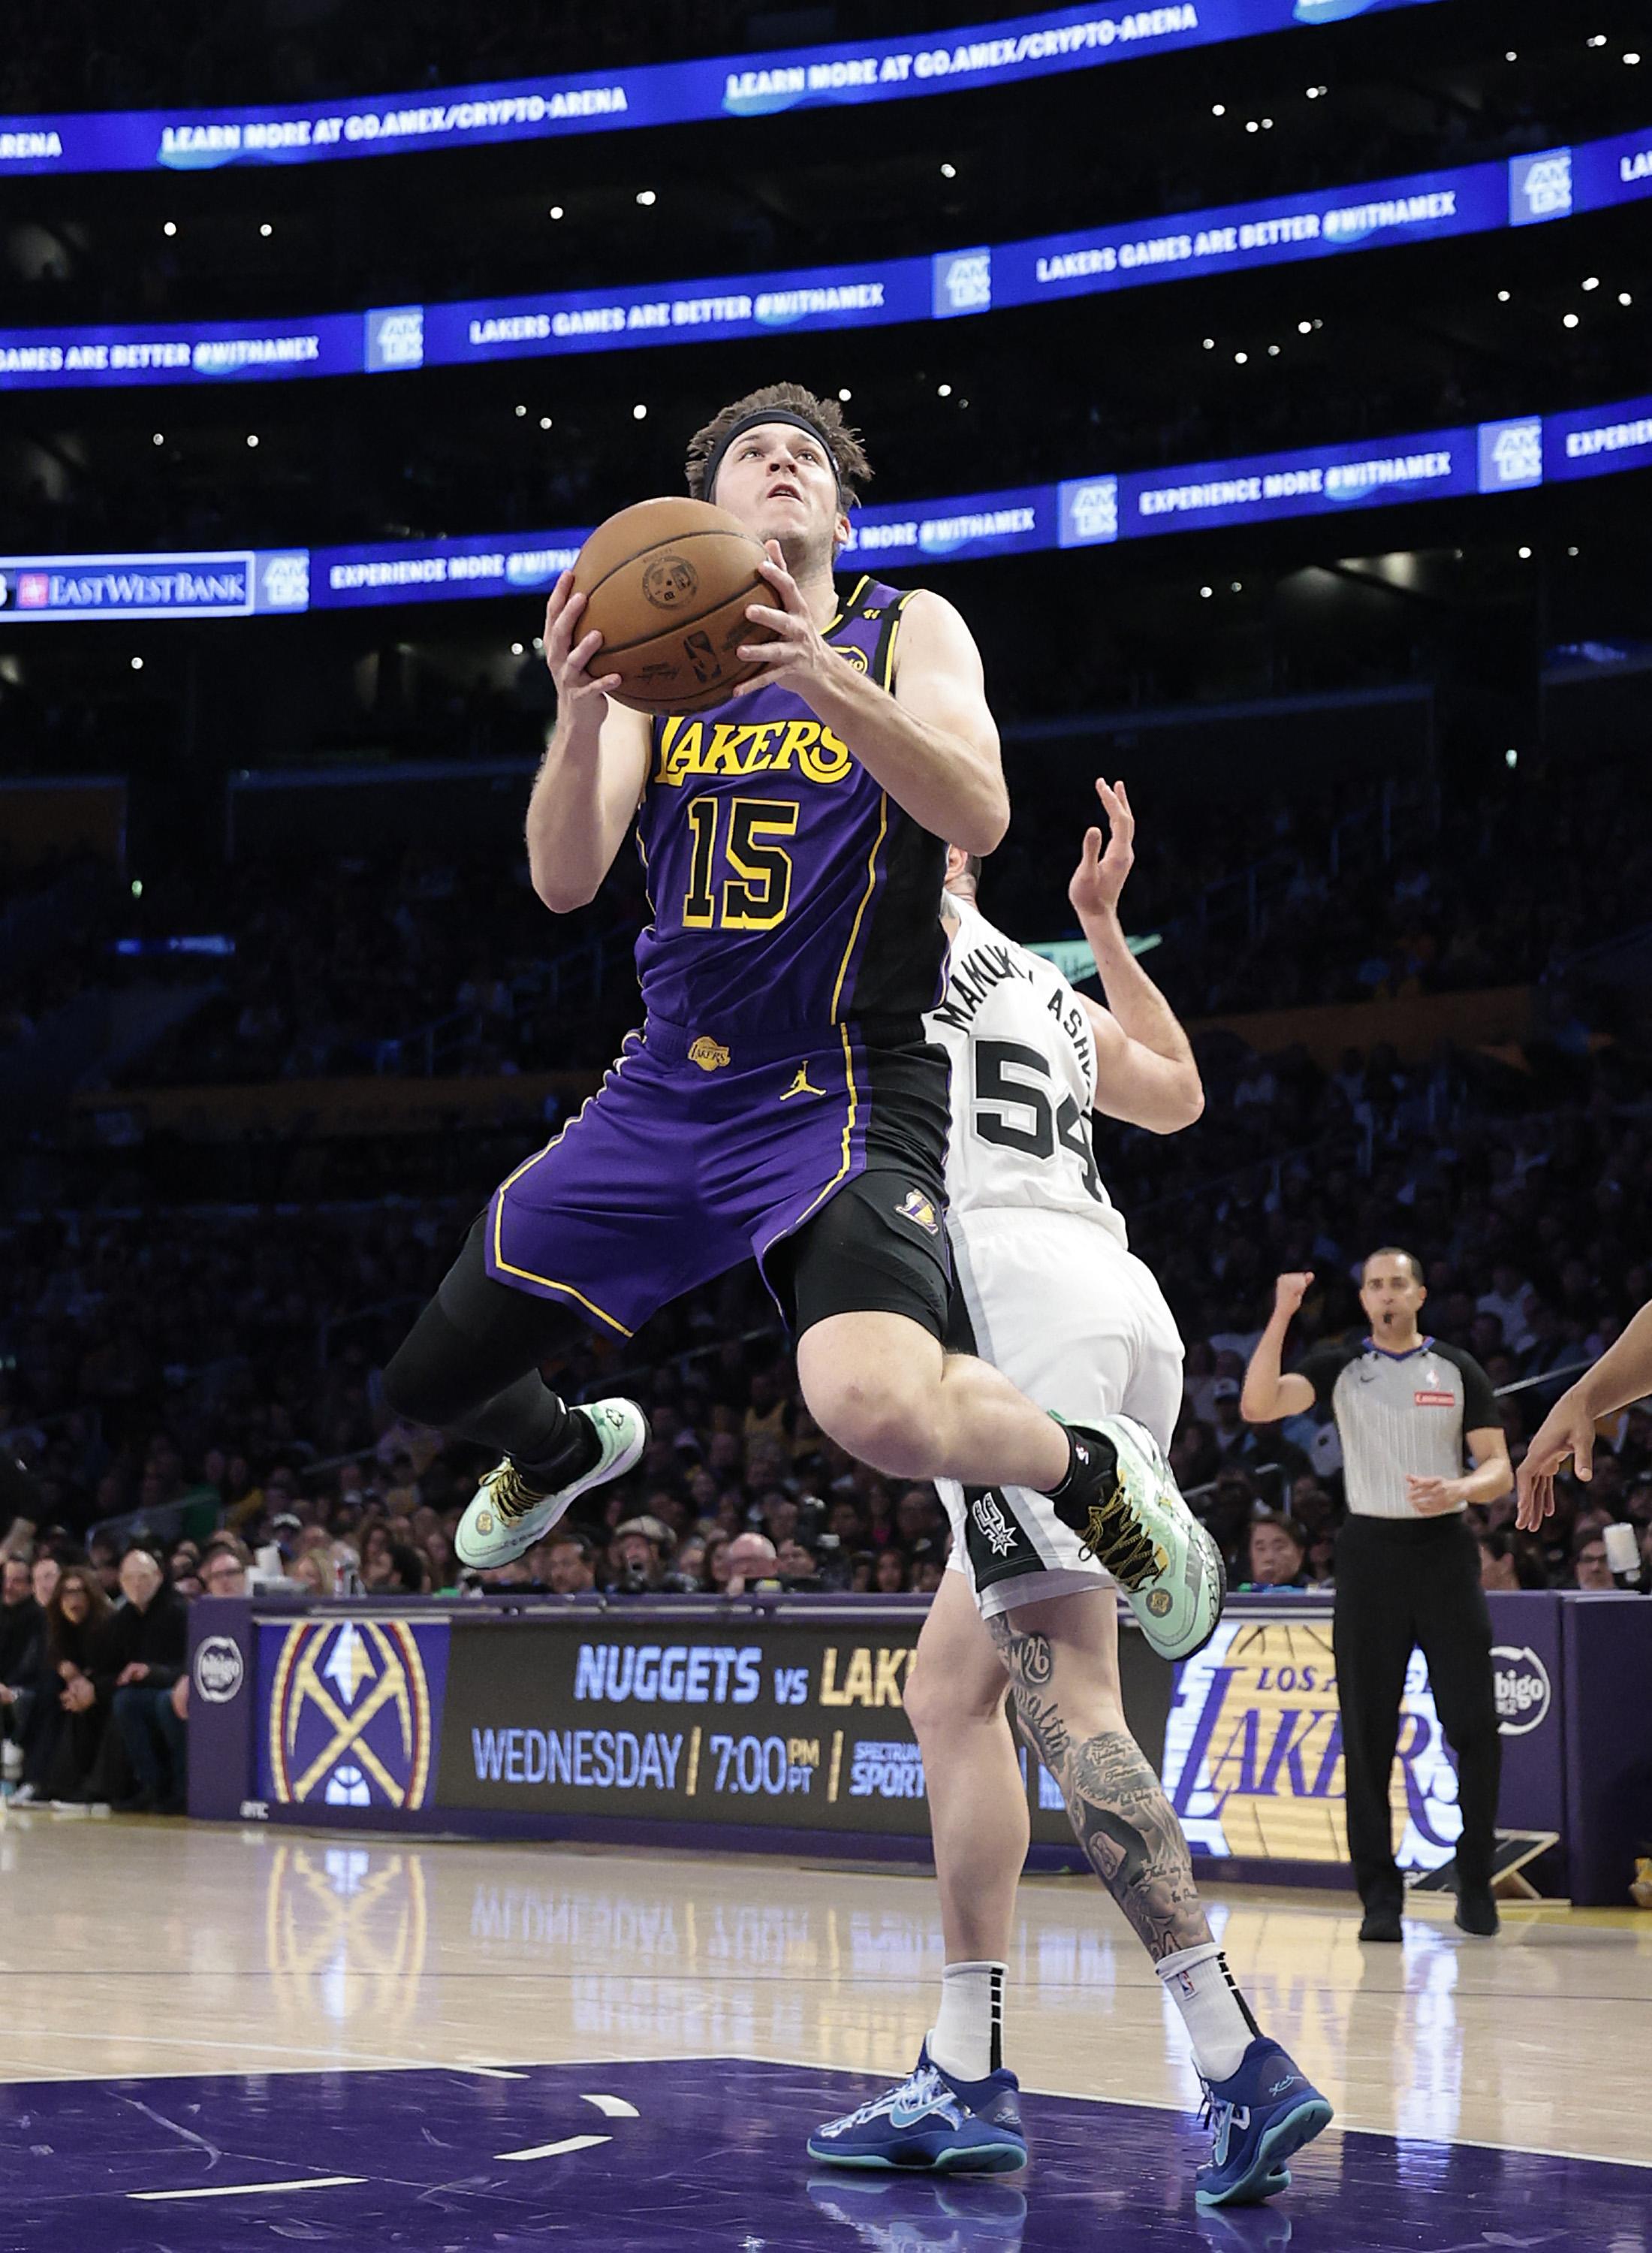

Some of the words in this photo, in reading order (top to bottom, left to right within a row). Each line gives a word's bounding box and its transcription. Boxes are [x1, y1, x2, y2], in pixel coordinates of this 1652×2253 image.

[727, 71, 805, 101] LEARN
[808, 59, 878, 89] MORE
[880, 54, 912, 82] AT
[0, 133, 62, 158] RENA
[162, 125, 241, 154] LEARN
[243, 121, 311, 148] MORE
[312, 118, 343, 143] AT
[1037, 247, 1117, 282] LAKERS
[1119, 235, 1192, 267] GAMES
[1194, 228, 1237, 255] ARE
[1240, 215, 1320, 249] BETTER
[1323, 192, 1455, 236] #WITHAMEX
[470, 313, 550, 343] LAKERS
[553, 308, 626, 336] GAMES
[628, 303, 670, 328] ARE
[672, 296, 752, 324] BETTER
[755, 285, 884, 318] #WITHAMEX
[65, 345, 108, 369] ARE
[110, 344, 191, 368] BETTER
[193, 336, 318, 366] #WITHAMEX
[1140, 478, 1262, 516] EXPERIENCE
[1264, 469, 1322, 499] MORE
[1325, 452, 1451, 490] #WITHAMEX
[860, 521, 917, 550] MORE
[919, 508, 1035, 541] #WITHAMEX
[330, 558, 446, 589] EXPERIENCE
[448, 554, 505, 579] MORE
[655, 716, 852, 786] LAKERS
[683, 797, 800, 930] 15
[574, 1644, 761, 1703] NUGGETS
[1256, 1666, 1319, 1692] LOS
[472, 1727, 683, 1791] WEDNESDAY
[788, 1739, 820, 1767] PM
[788, 1766, 813, 1794] PT
